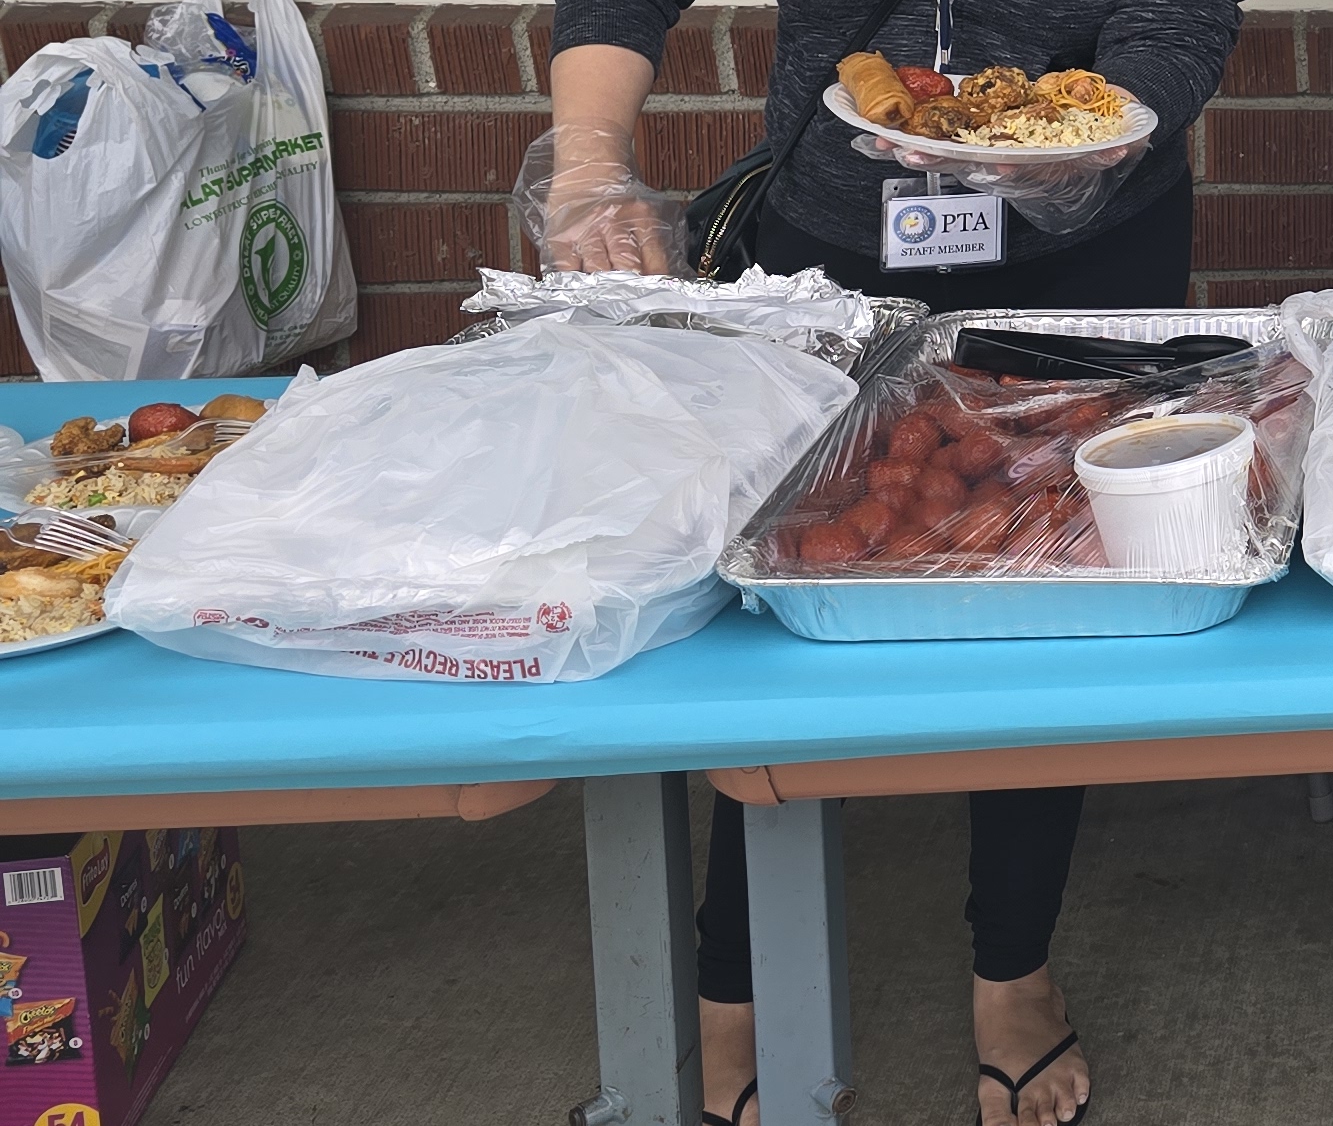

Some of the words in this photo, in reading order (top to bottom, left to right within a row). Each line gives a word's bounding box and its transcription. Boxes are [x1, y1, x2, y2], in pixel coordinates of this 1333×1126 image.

[940, 211, 991, 234] PTA
[901, 246, 935, 257] STAFF
[937, 242, 986, 255] MEMBER
[454, 626, 467, 634] THIS
[384, 648, 459, 678] RECYCLE
[463, 657, 541, 680] PLEASE
[176, 954, 194, 994] fun
[196, 899, 226, 961] flavor
